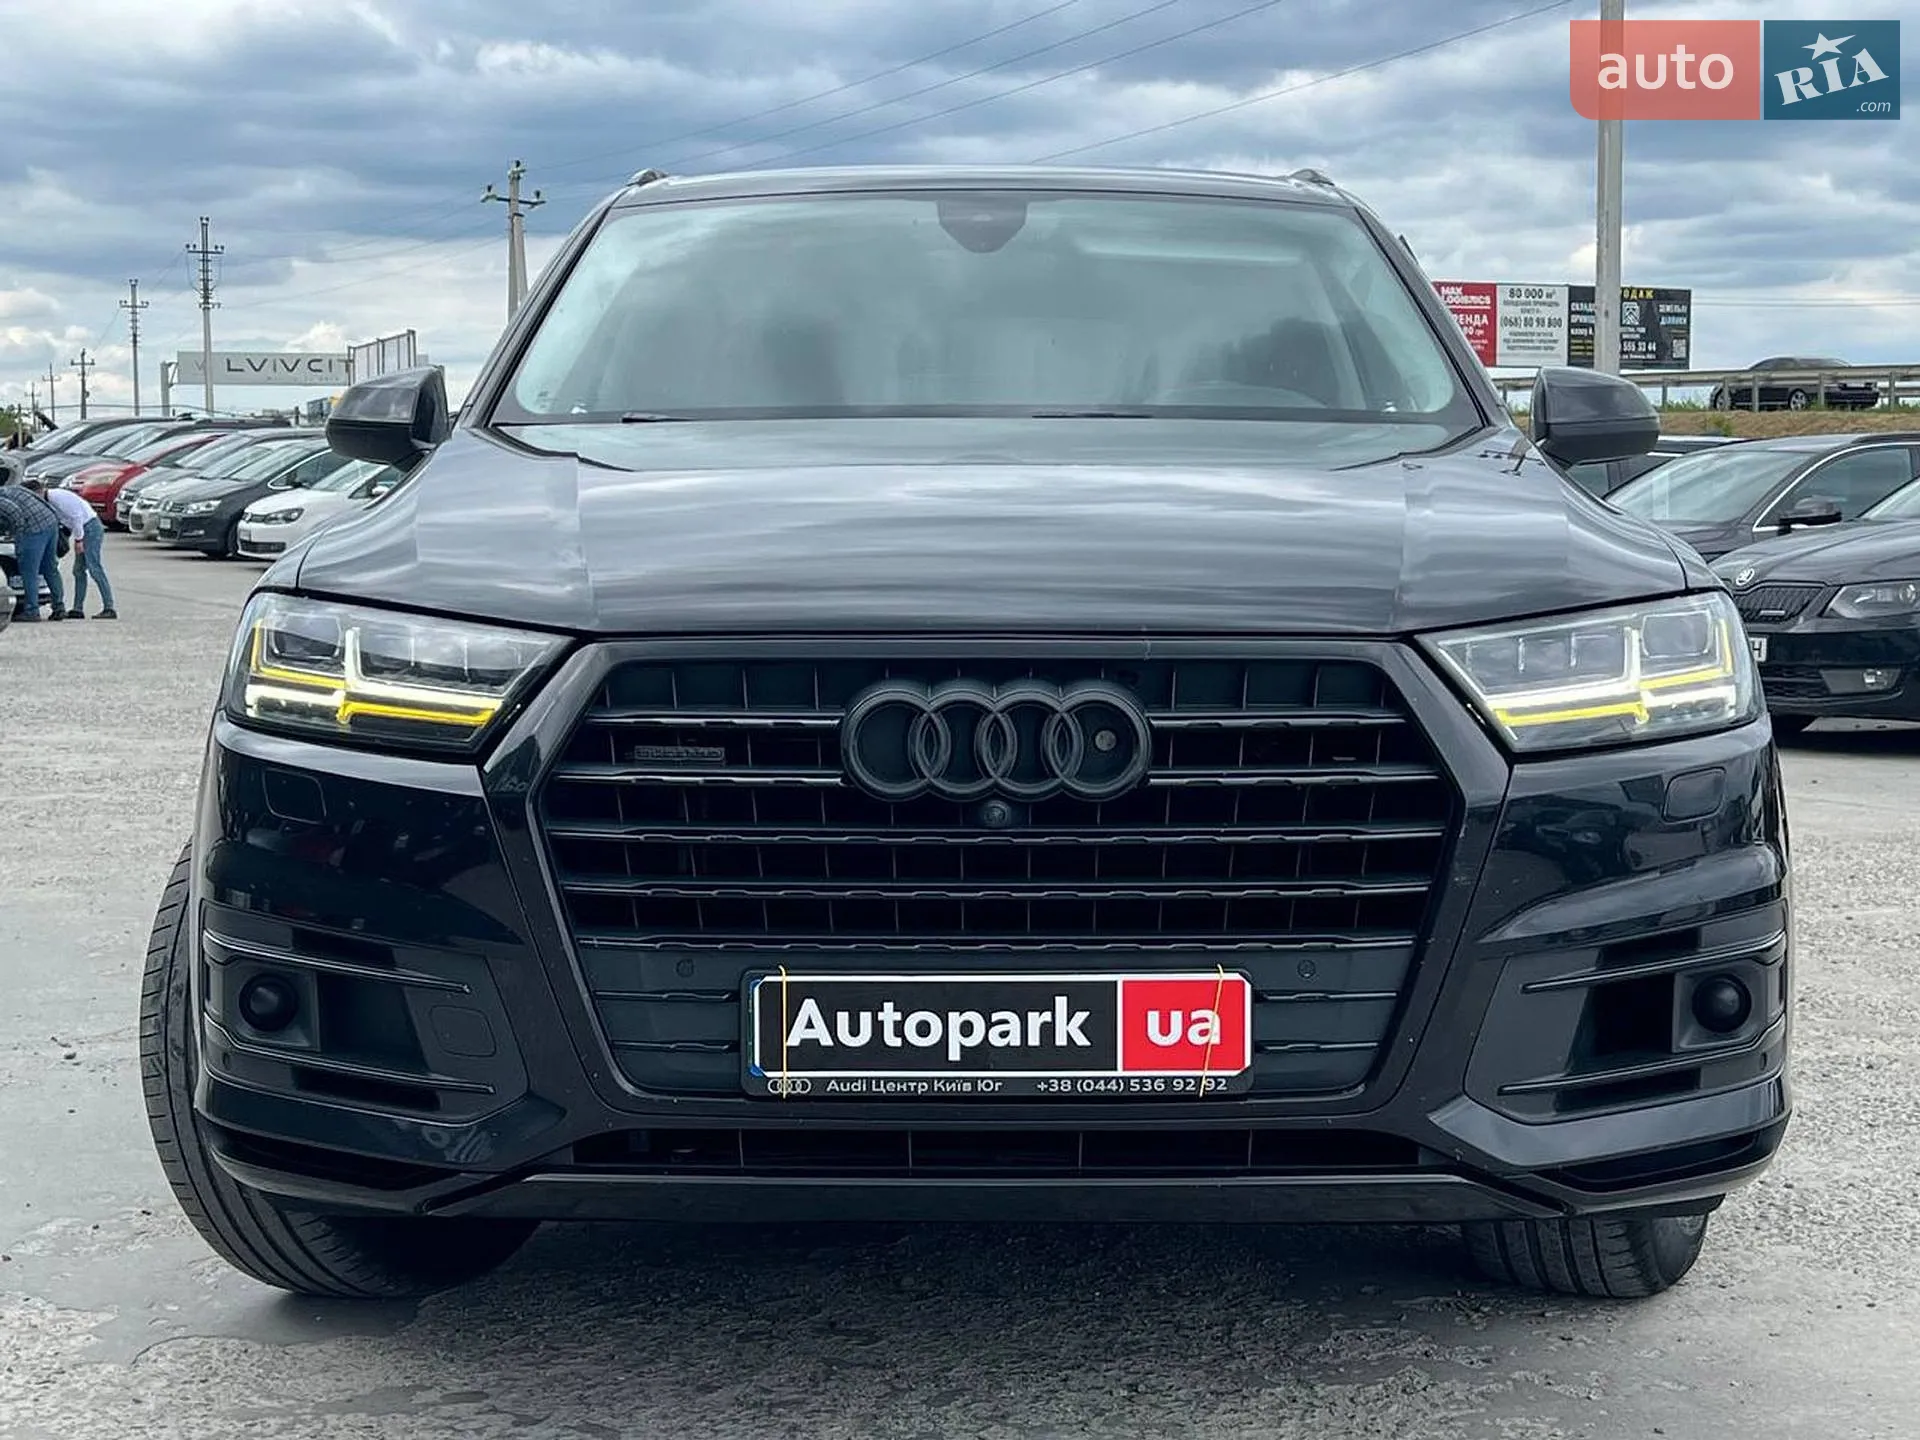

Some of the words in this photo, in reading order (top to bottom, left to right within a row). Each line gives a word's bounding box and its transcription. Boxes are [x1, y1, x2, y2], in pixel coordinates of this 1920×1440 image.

[1508, 288, 1522, 299] 80
[1523, 288, 1544, 299] 000
[786, 996, 1091, 1061] Autopark
[1146, 1009, 1221, 1047] ua
[826, 1079, 867, 1092] Audi
[871, 1079, 928, 1094] Центр
[933, 1078, 972, 1092] Київ
[977, 1079, 1003, 1092] Юг
[1129, 1079, 1165, 1091] 536
[1172, 1079, 1196, 1091] 92
[1204, 1079, 1228, 1091] 92
